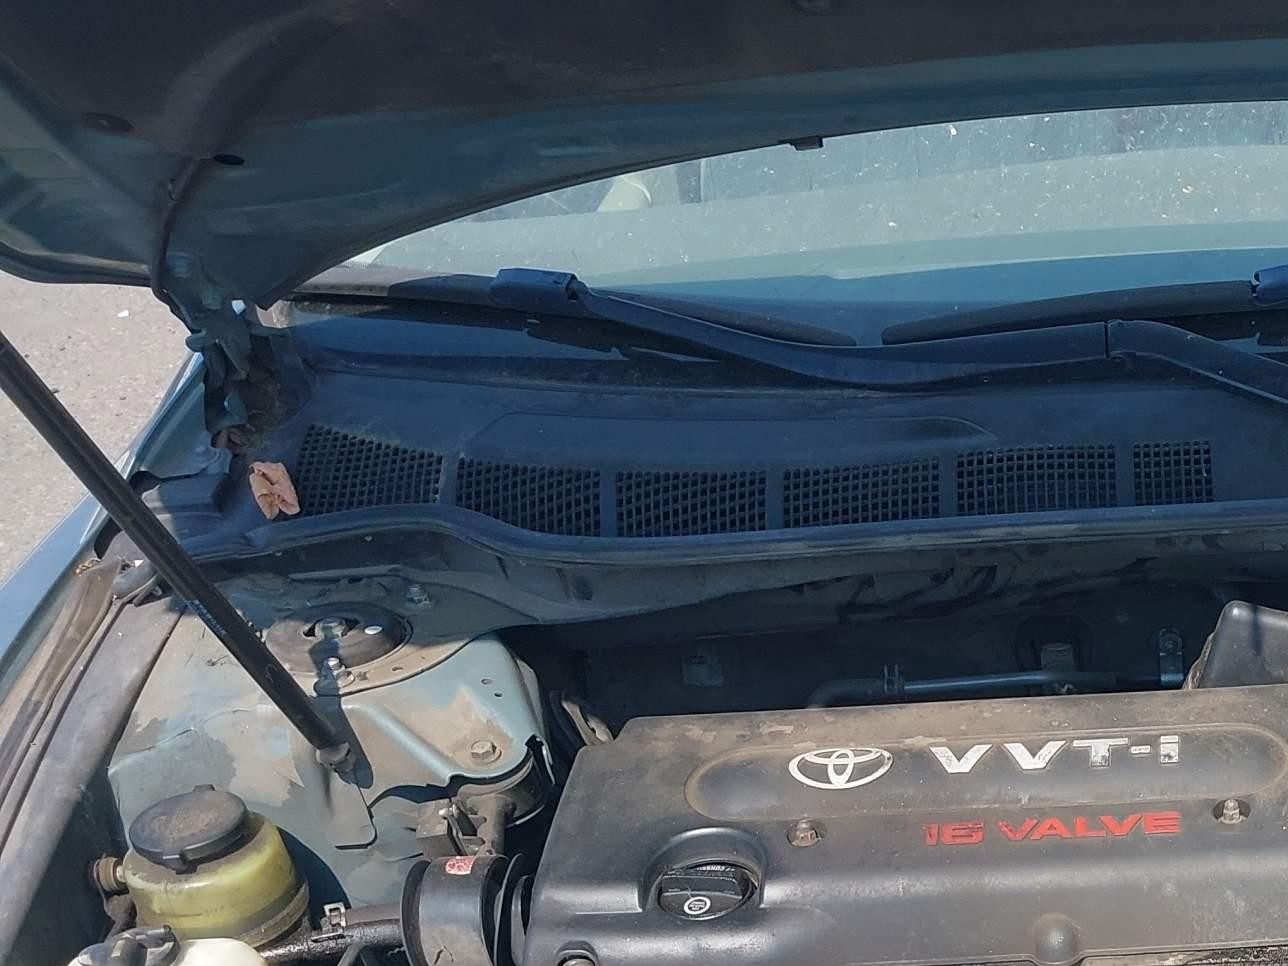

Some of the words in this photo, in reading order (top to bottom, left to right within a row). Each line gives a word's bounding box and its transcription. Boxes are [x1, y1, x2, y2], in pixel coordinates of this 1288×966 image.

[929, 735, 1181, 774] VVT-i
[923, 822, 985, 847] 16
[997, 811, 1182, 841] VALVE
